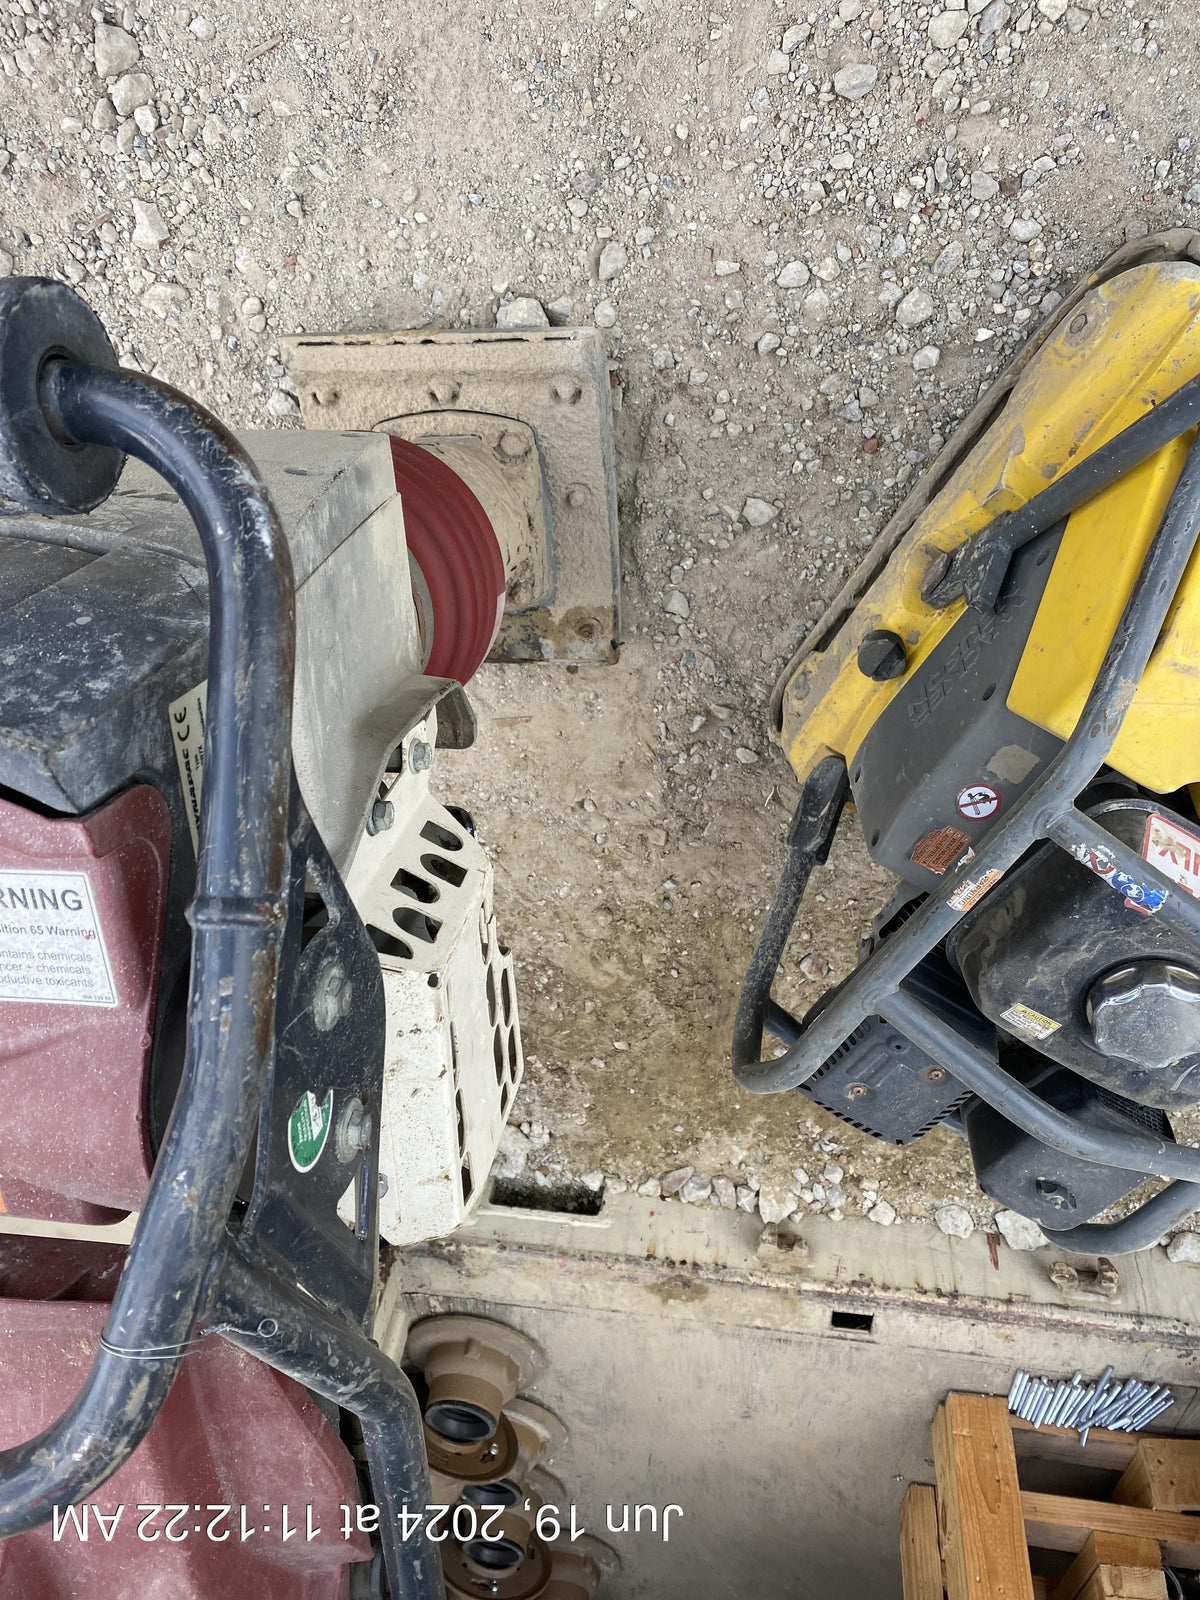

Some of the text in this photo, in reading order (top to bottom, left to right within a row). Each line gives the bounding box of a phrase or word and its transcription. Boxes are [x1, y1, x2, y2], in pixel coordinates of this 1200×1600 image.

[30, 926, 44, 935] 65
[46, 926, 96, 940] Warning
[38, 951, 93, 962] chemicals
[36, 963, 91, 975] chemicals
[46, 976, 94, 988] toxicants
[1027, 1011, 1053, 1026] CAUTION
